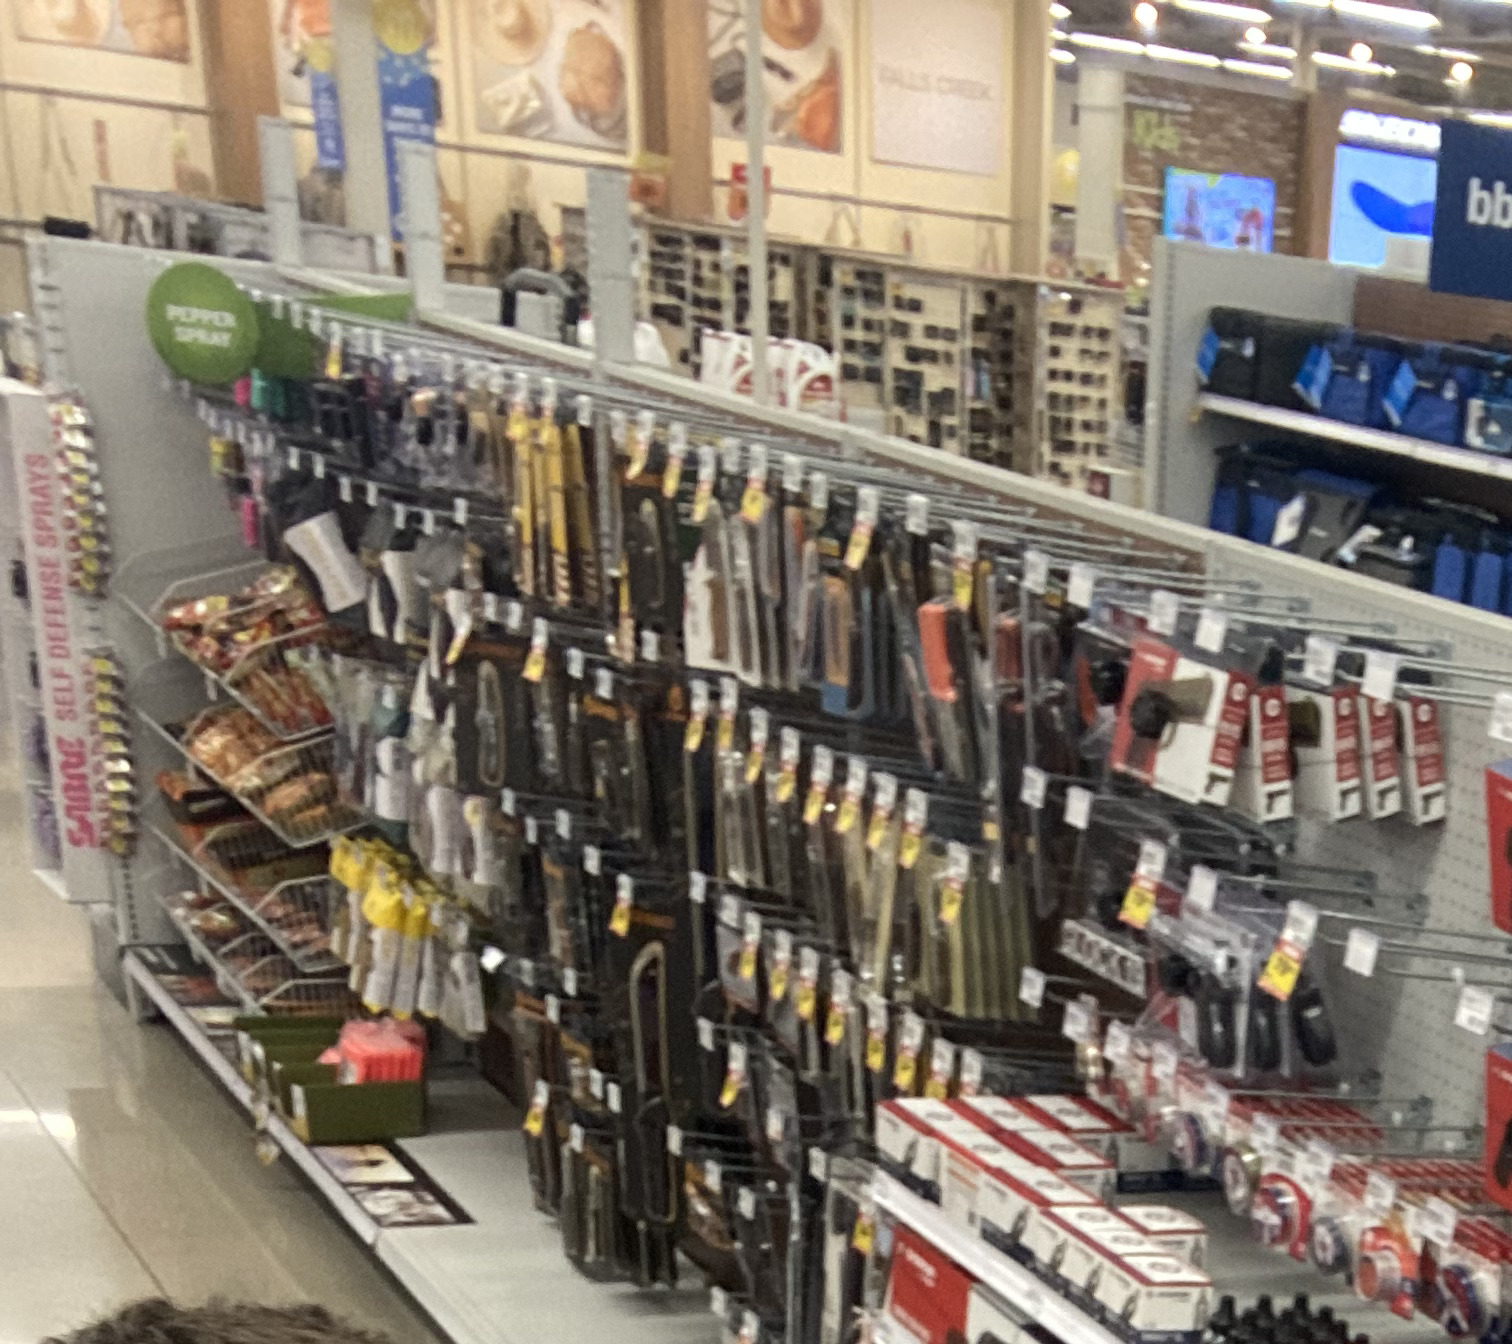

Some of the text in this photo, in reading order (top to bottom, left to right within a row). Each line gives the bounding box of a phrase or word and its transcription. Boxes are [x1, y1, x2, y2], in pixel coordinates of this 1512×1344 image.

[163, 301, 238, 331] PEPPER
[174, 326, 235, 351] SPRAY
[23, 452, 57, 547] SPRAYS
[38, 554, 72, 658] DEFENSE
[45, 662, 78, 722] SELF
